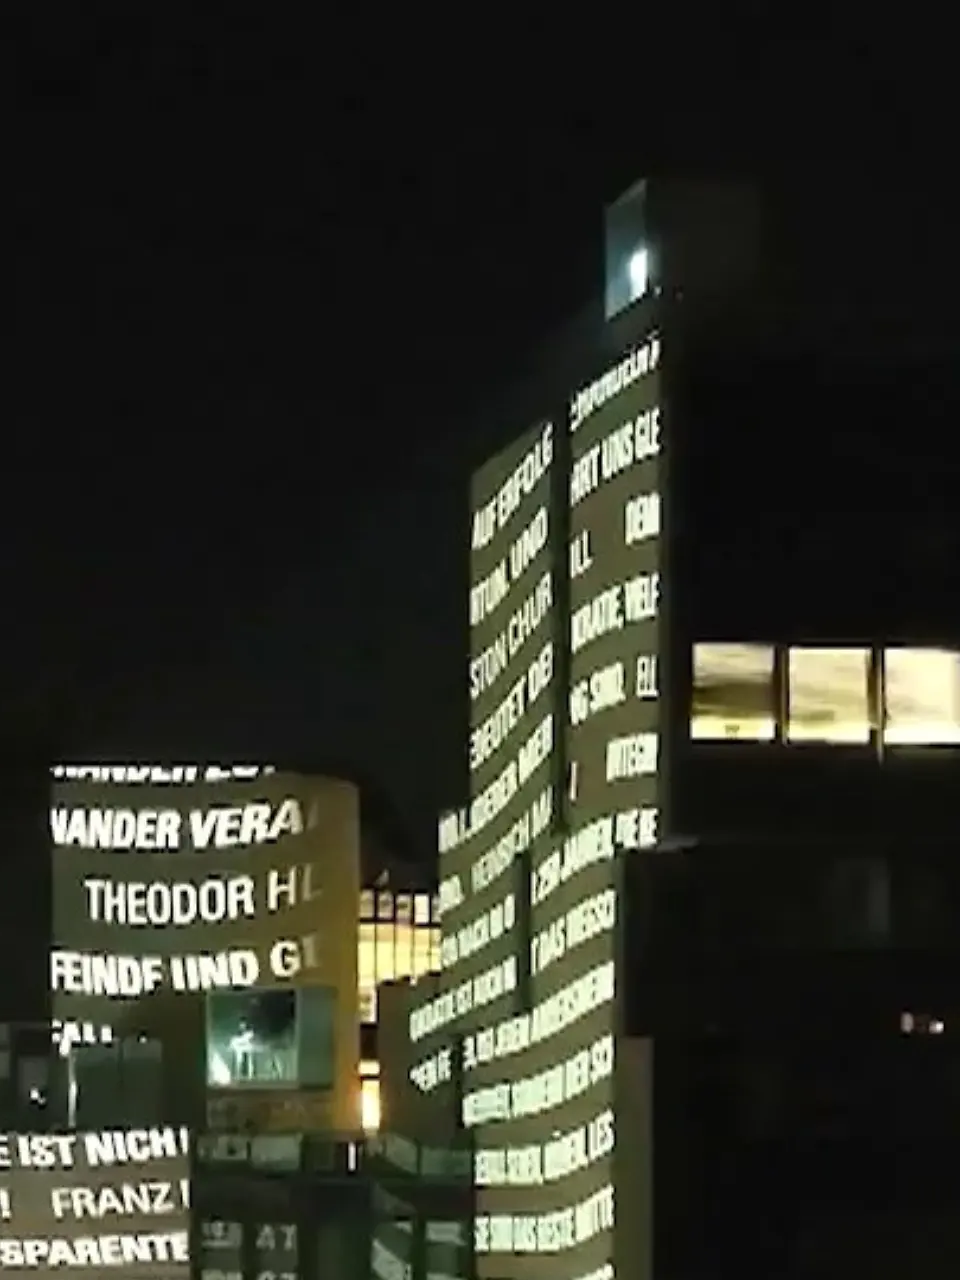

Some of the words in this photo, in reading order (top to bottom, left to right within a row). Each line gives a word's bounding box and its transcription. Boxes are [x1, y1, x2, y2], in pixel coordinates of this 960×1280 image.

[189, 798, 304, 848] VERA
[84, 875, 255, 925] THEODOR
[17, 1132, 76, 1167] IST
[51, 1182, 174, 1220] FRANZ
